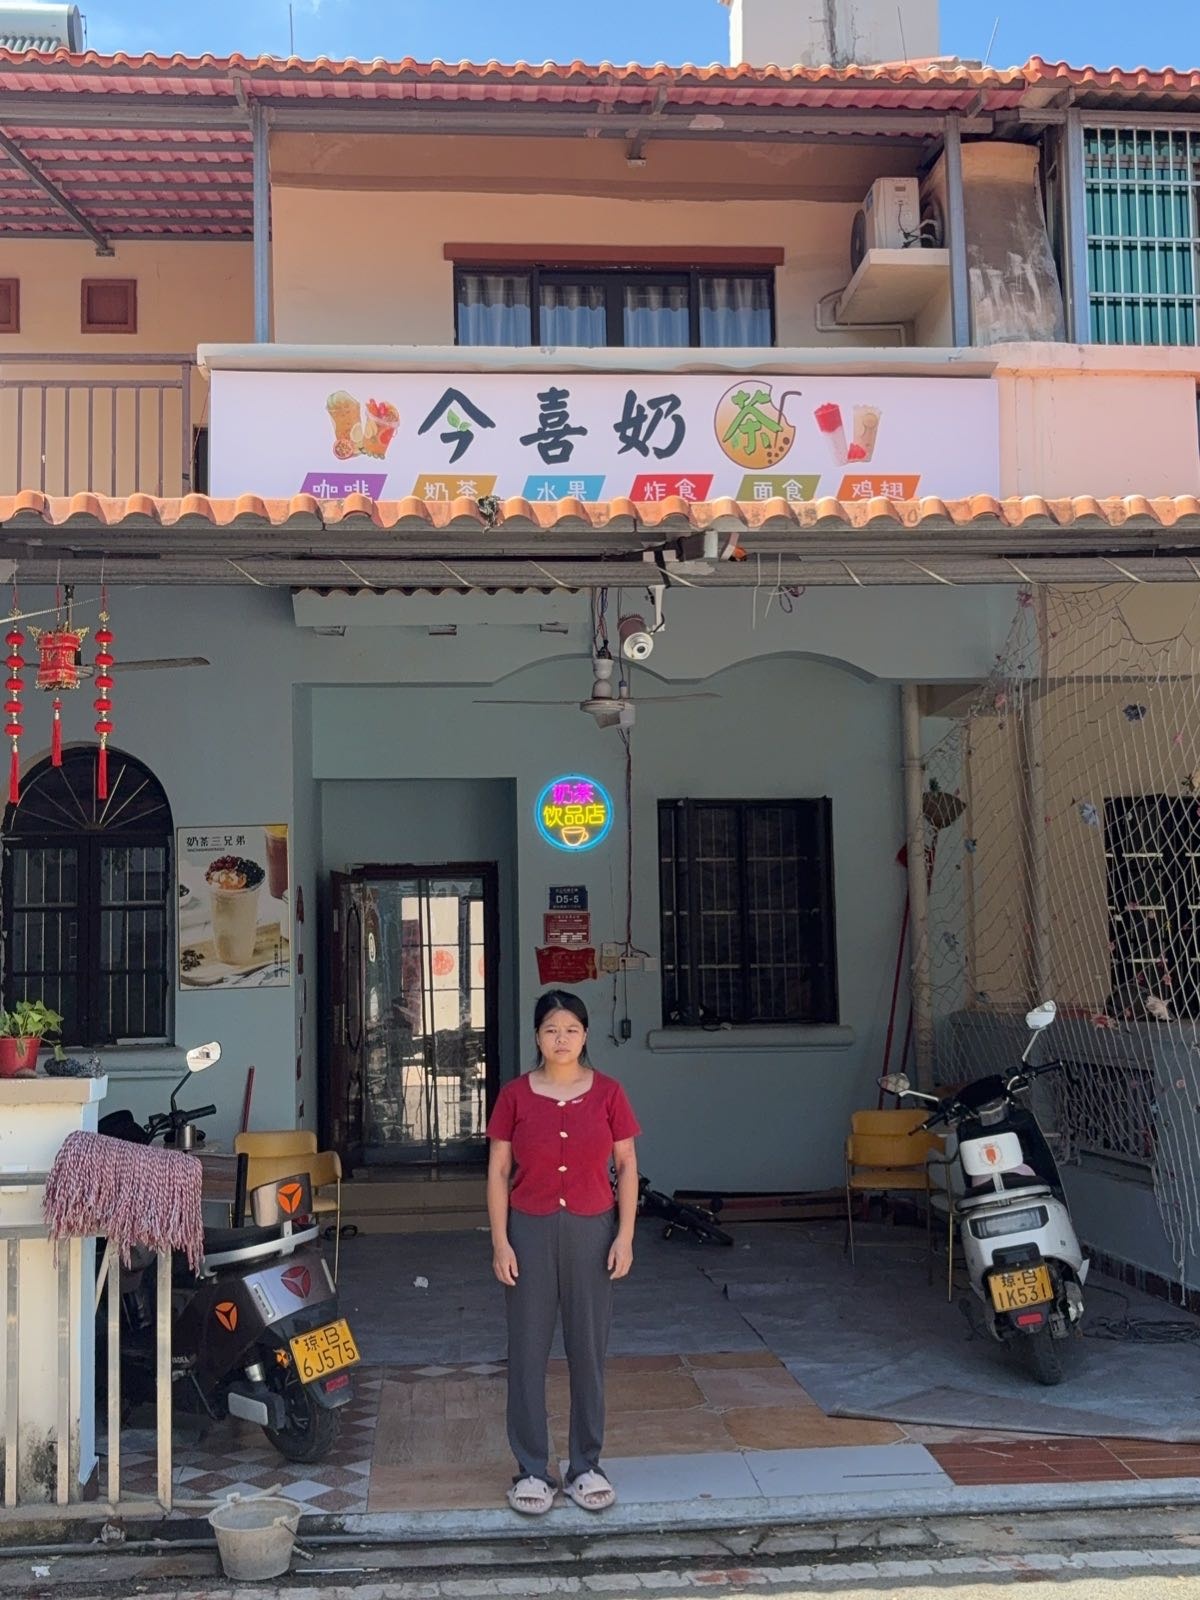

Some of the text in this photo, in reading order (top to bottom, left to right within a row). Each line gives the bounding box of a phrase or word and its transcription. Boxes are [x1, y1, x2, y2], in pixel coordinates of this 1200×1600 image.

[418, 386, 783, 465] 今喜奶茶
[312, 478, 905, 502] 咖啡 奶茶 水果 炸食 面食 鸡翅
[552, 783, 594, 804] 奶茶
[543, 805, 606, 827] 饮品店
[186, 835, 246, 848] 奶茶三兄弟
[556, 895, 579, 904] D5-5
[998, 1283, 1047, 1308] 1K531
[303, 1340, 356, 1378] 6J575
